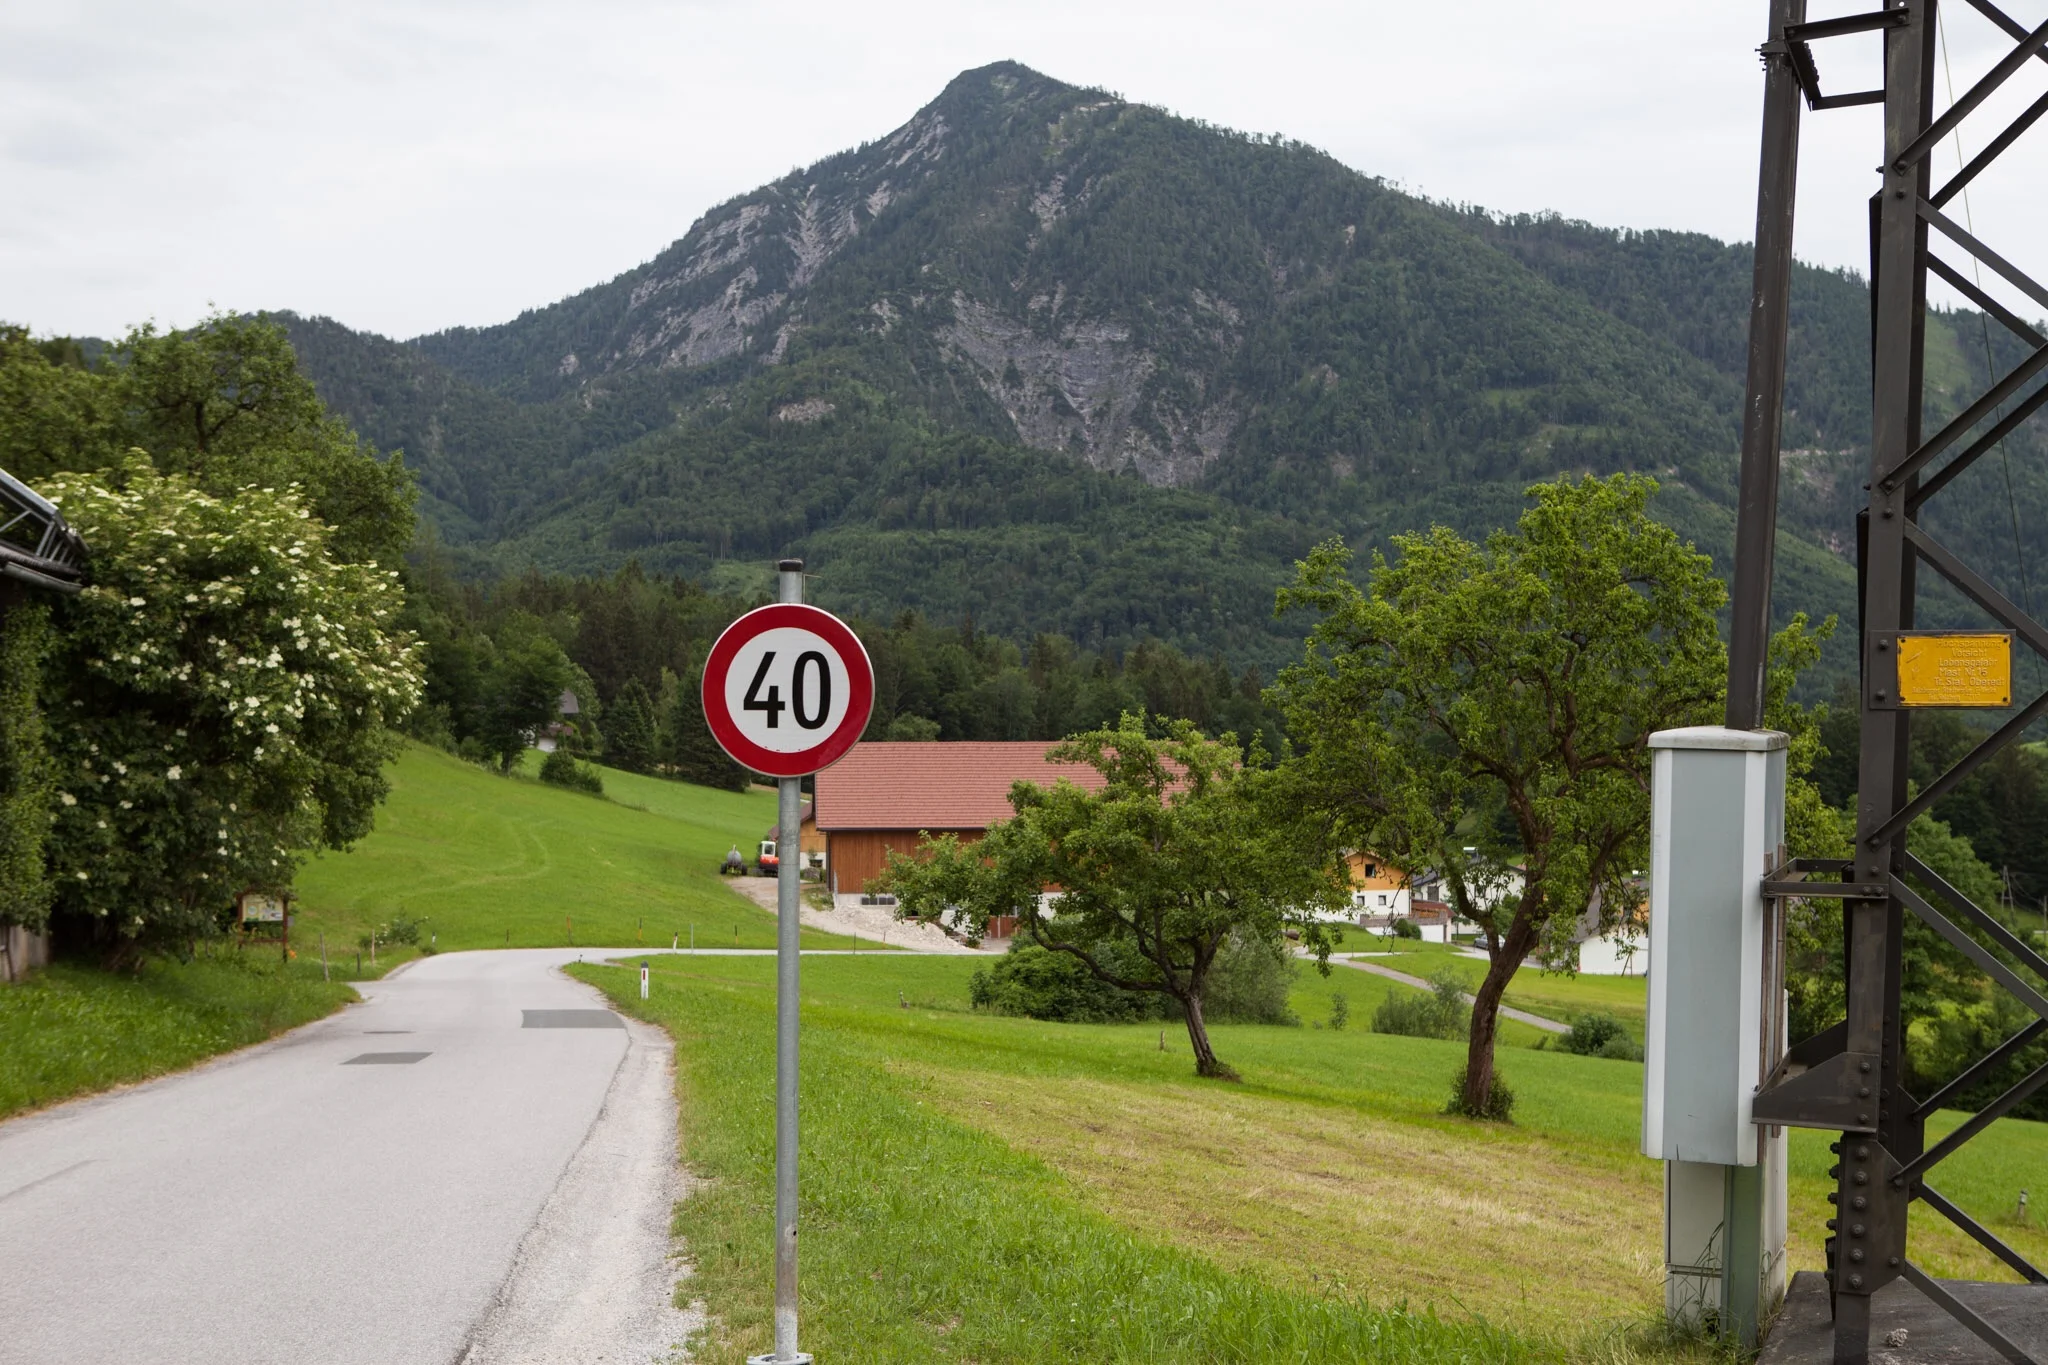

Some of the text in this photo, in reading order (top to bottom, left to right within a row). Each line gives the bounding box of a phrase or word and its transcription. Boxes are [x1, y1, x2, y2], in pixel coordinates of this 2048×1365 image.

[1952, 648, 1987, 657] Vorsicht
[1939, 657, 1998, 669] Lebensgefahr
[1939, 667, 1961, 677] Mast
[743, 650, 831, 730] 40
